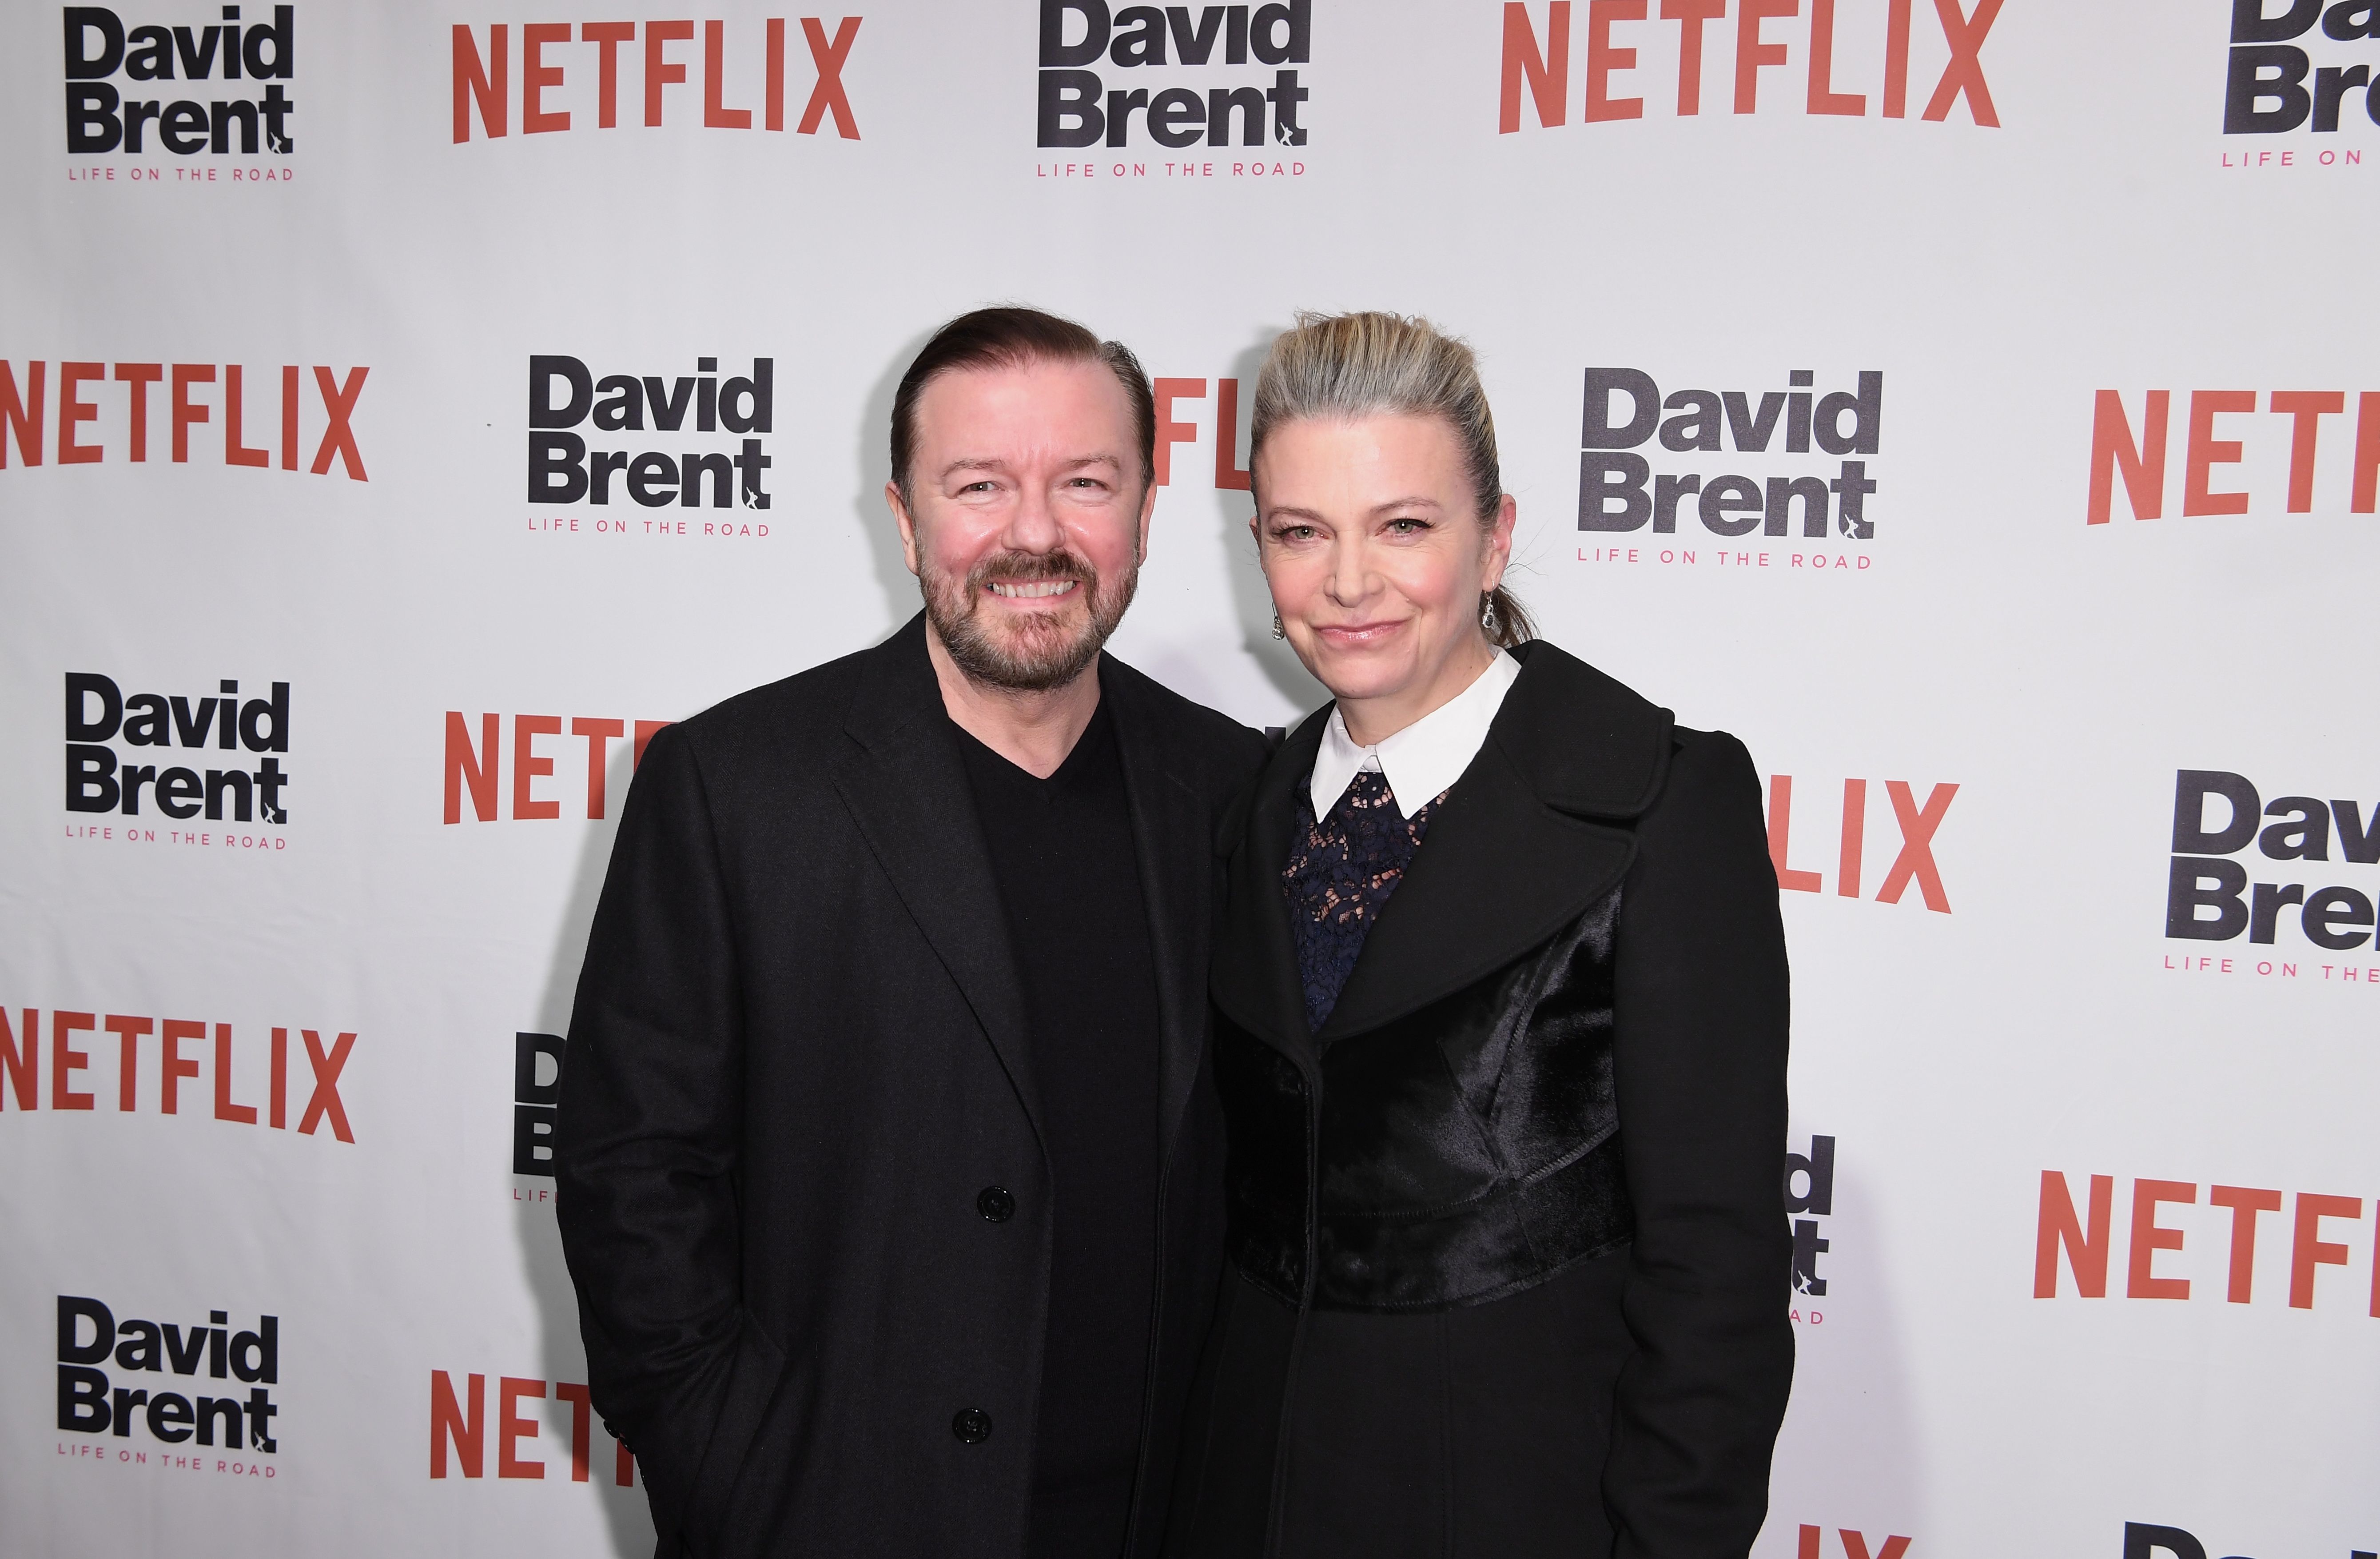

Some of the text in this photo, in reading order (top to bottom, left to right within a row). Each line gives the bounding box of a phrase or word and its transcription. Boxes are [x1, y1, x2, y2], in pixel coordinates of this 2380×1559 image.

[64, 5, 293, 81] David
[1039, 0, 1311, 67] David
[1499, 0, 2004, 134] NETFLIX
[65, 82, 293, 155] Brent
[452, 16, 863, 144] NETFLIX
[1037, 70, 1308, 148] Brent
[68, 167, 293, 182] LIFE ON THE ROAD
[1037, 161, 1305, 178] LIFE ON THE ROAD
[2221, 149, 2362, 168] LIFE ON
[0, 359, 370, 482] NETFLIX
[529, 355, 773, 434] David
[1581, 367, 1883, 455] David
[528, 431, 772, 510] Brent
[1577, 451, 1877, 539] Brent
[528, 518, 770, 538] LIFE ON THE ROAD
[1577, 547, 1871, 570] LIFE ON THE ROAD
[65, 672, 290, 753] David
[66, 743, 288, 824] Brent
[66, 826, 287, 851] LIFE ON THE ROAD
[2165, 856, 2380, 951] Bre
[2164, 955, 2380, 984] LIFE ON THE
[0, 1006, 357, 1144] NETFLIX
[513, 1188, 557, 1204] LIF
[57, 1295, 278, 1385] David
[57, 1364, 277, 1454] Brent
[58, 1443, 276, 1479] LIFE ON THE ROAD
